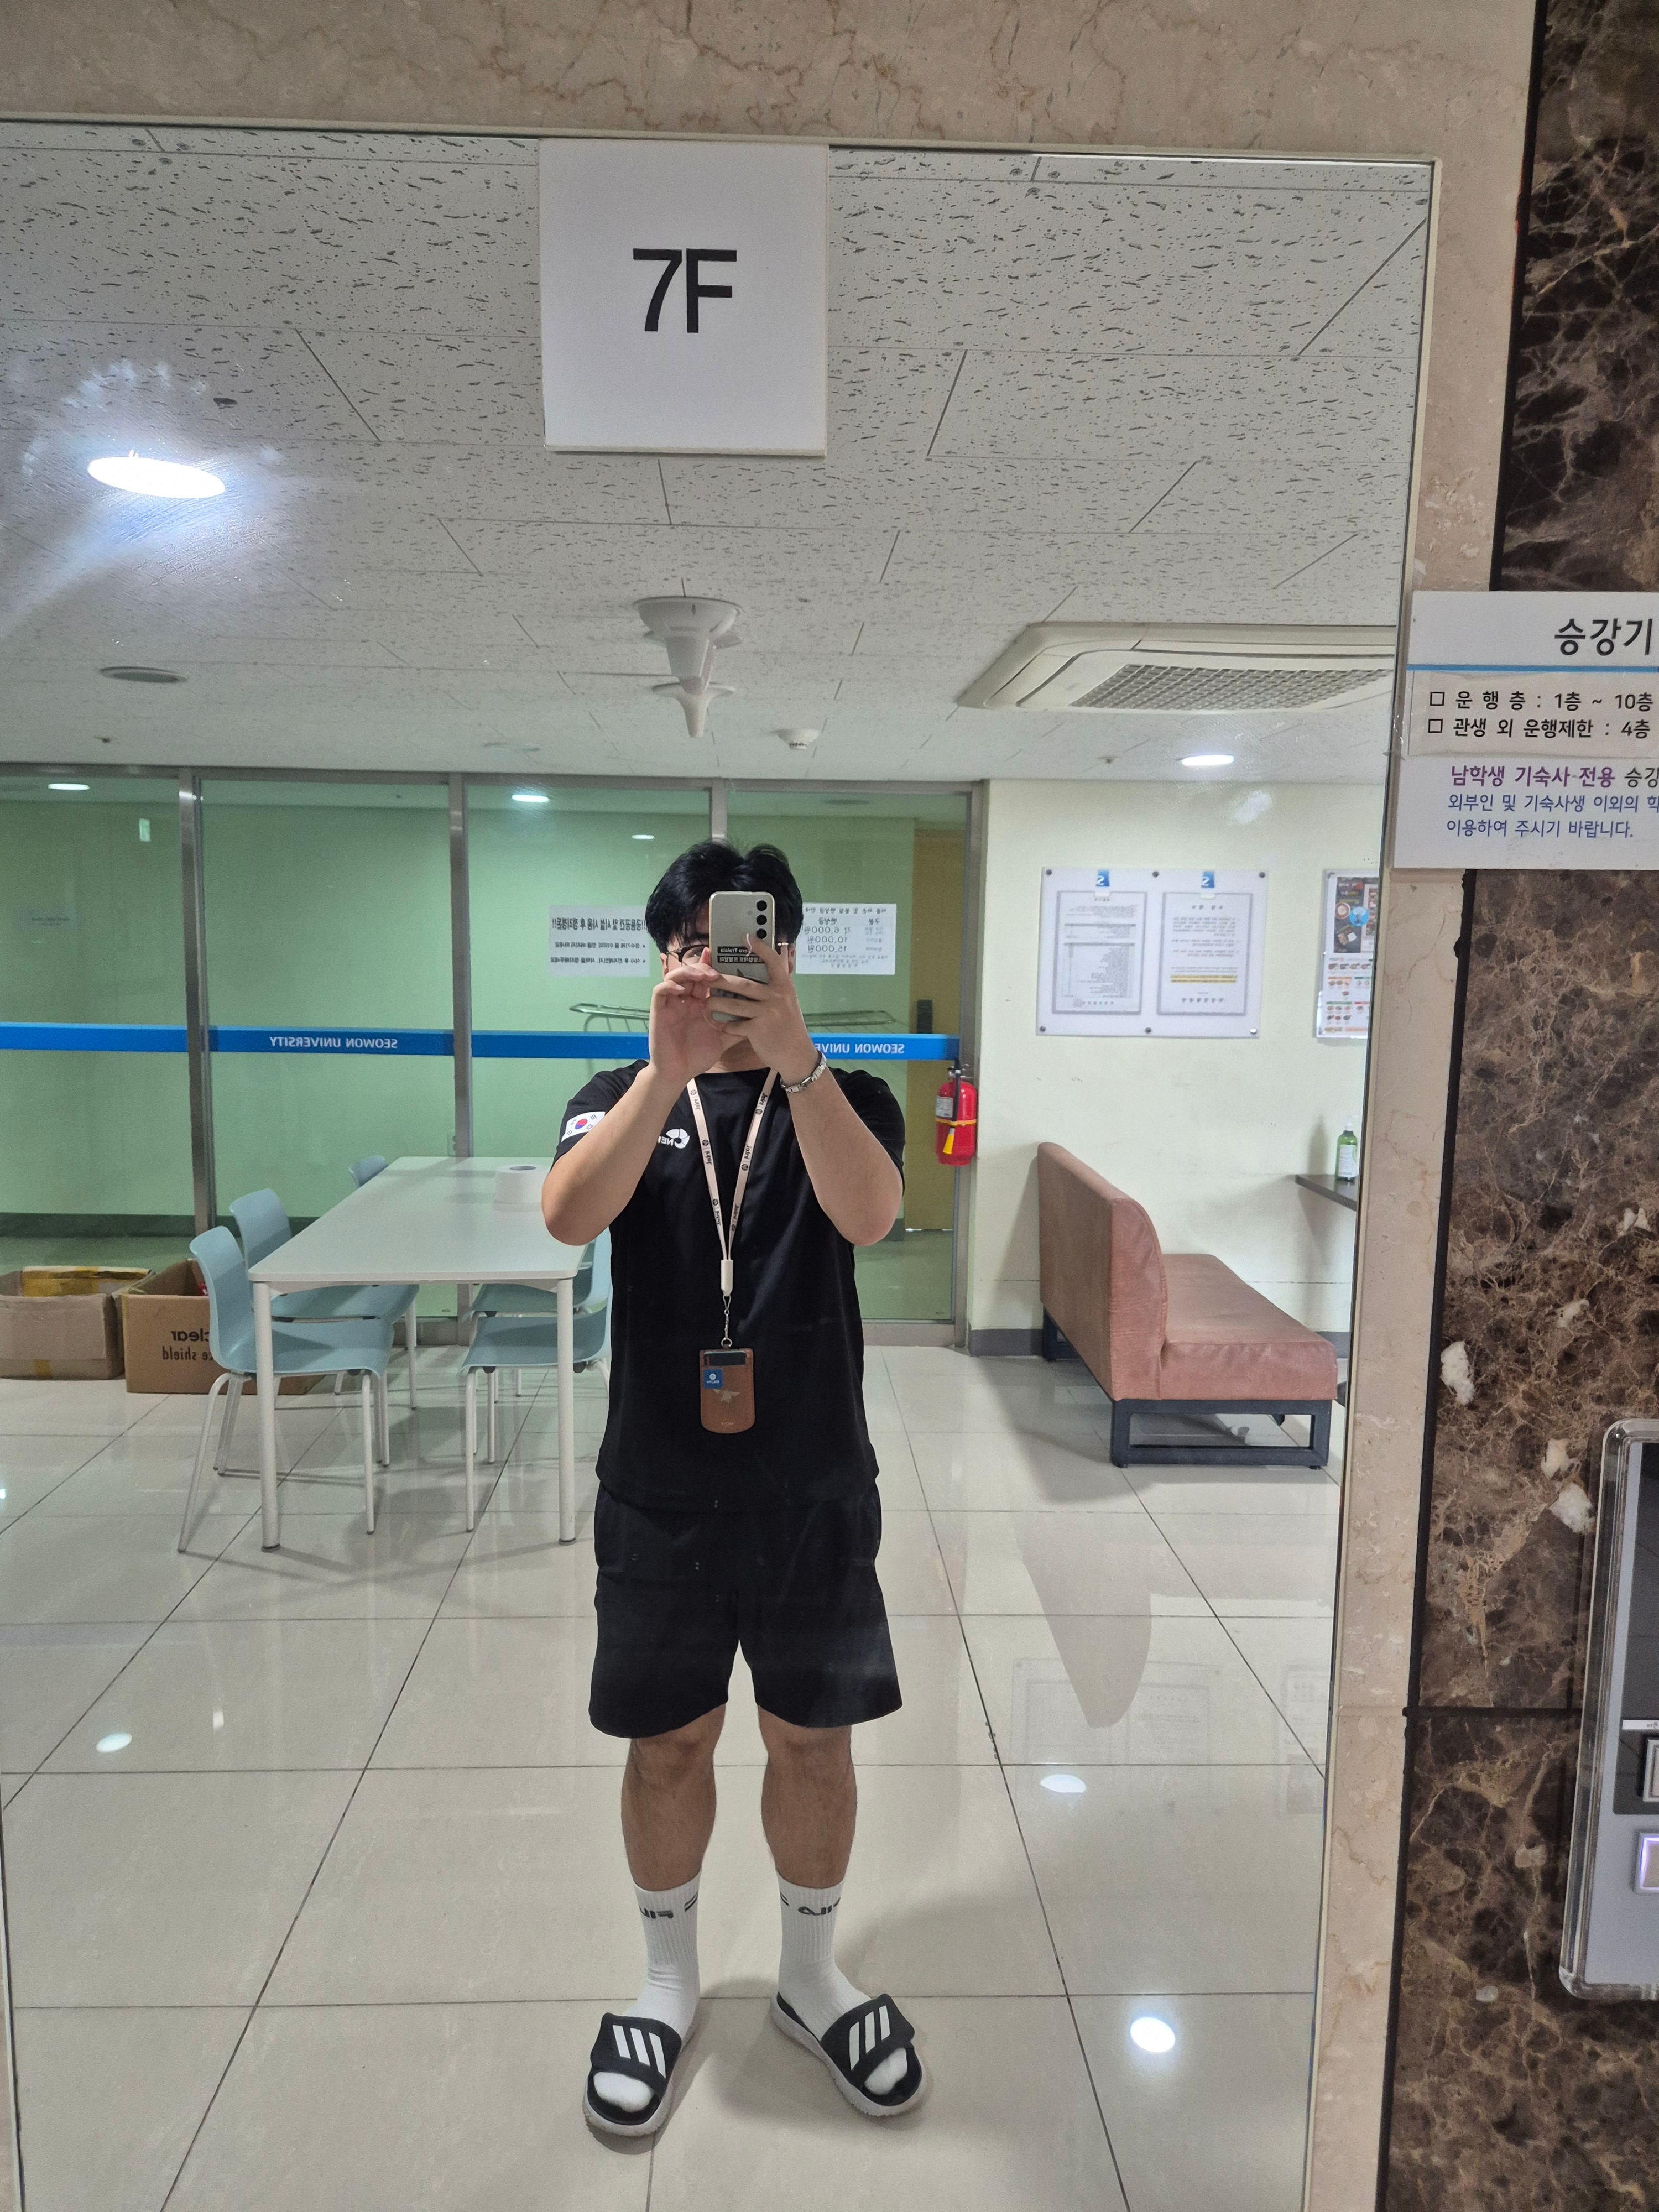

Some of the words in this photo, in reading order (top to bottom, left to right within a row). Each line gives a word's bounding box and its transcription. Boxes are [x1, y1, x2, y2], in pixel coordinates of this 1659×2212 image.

[633, 248, 737, 333] 7F
[1554, 618, 1653, 656] 승강기
[1455, 691, 1473, 709] 운
[1482, 691, 1499, 709] 행
[1509, 691, 1526, 711] 층
[1554, 691, 1582, 711] 1층
[1615, 692, 1653, 712] 10층
[1453, 718, 1486, 738] 관생
[1496, 718, 1514, 738] 외
[1523, 719, 1594, 738] 운행제한
[1621, 719, 1651, 739] 4층
[1451, 765, 1505, 787] 남학생
[1514, 766, 1571, 787] 기숙사
[1578, 766, 1616, 788] 전용
[1448, 794, 1493, 811] 외부인
[1502, 794, 1516, 812] 및
[1524, 794, 1585, 813] 기숙사생
[1593, 795, 1639, 813] 이외의
[1447, 819, 1507, 837] 이용하여
[1514, 820, 1560, 838] 주시기
[1568, 820, 1633, 838] 바랍니다.
